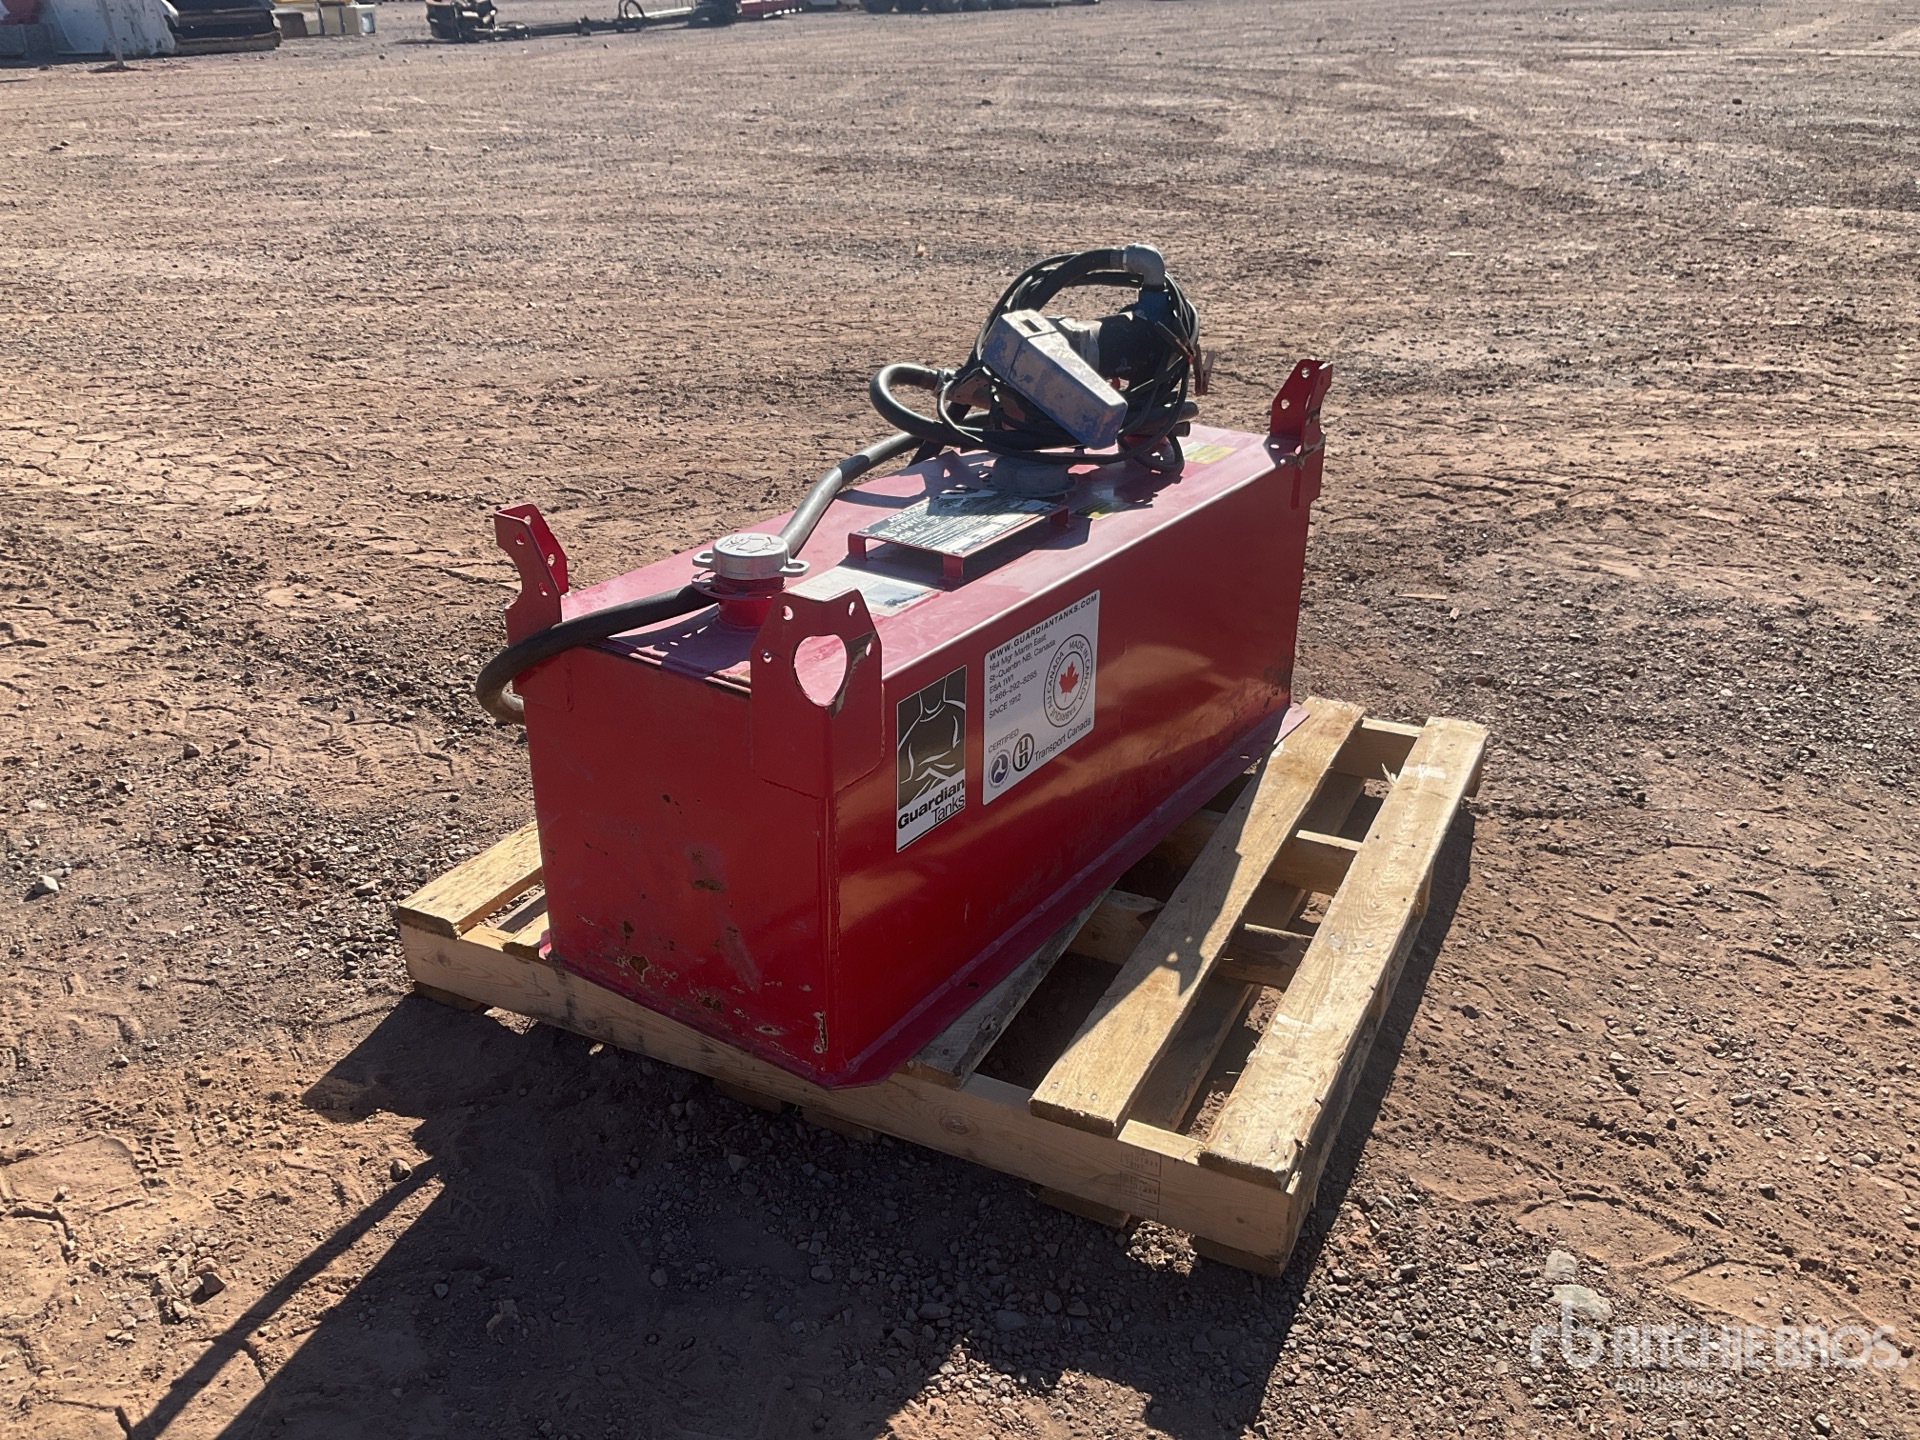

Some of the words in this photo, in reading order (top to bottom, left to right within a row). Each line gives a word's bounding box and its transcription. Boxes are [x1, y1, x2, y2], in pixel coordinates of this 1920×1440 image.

[989, 594, 1097, 661] WWW.GUARDIANTANKS.COM
[1015, 643, 1032, 657] Martin
[1034, 640, 1056, 657] Canada
[1047, 651, 1065, 694] CANADA
[989, 701, 1008, 719] SINCE
[988, 728, 1019, 754] CERTIFIED
[1035, 734, 1066, 761] Transport
[1067, 717, 1092, 739] Canada
[897, 779, 965, 830] Guardian
[931, 795, 965, 824] Tanks
